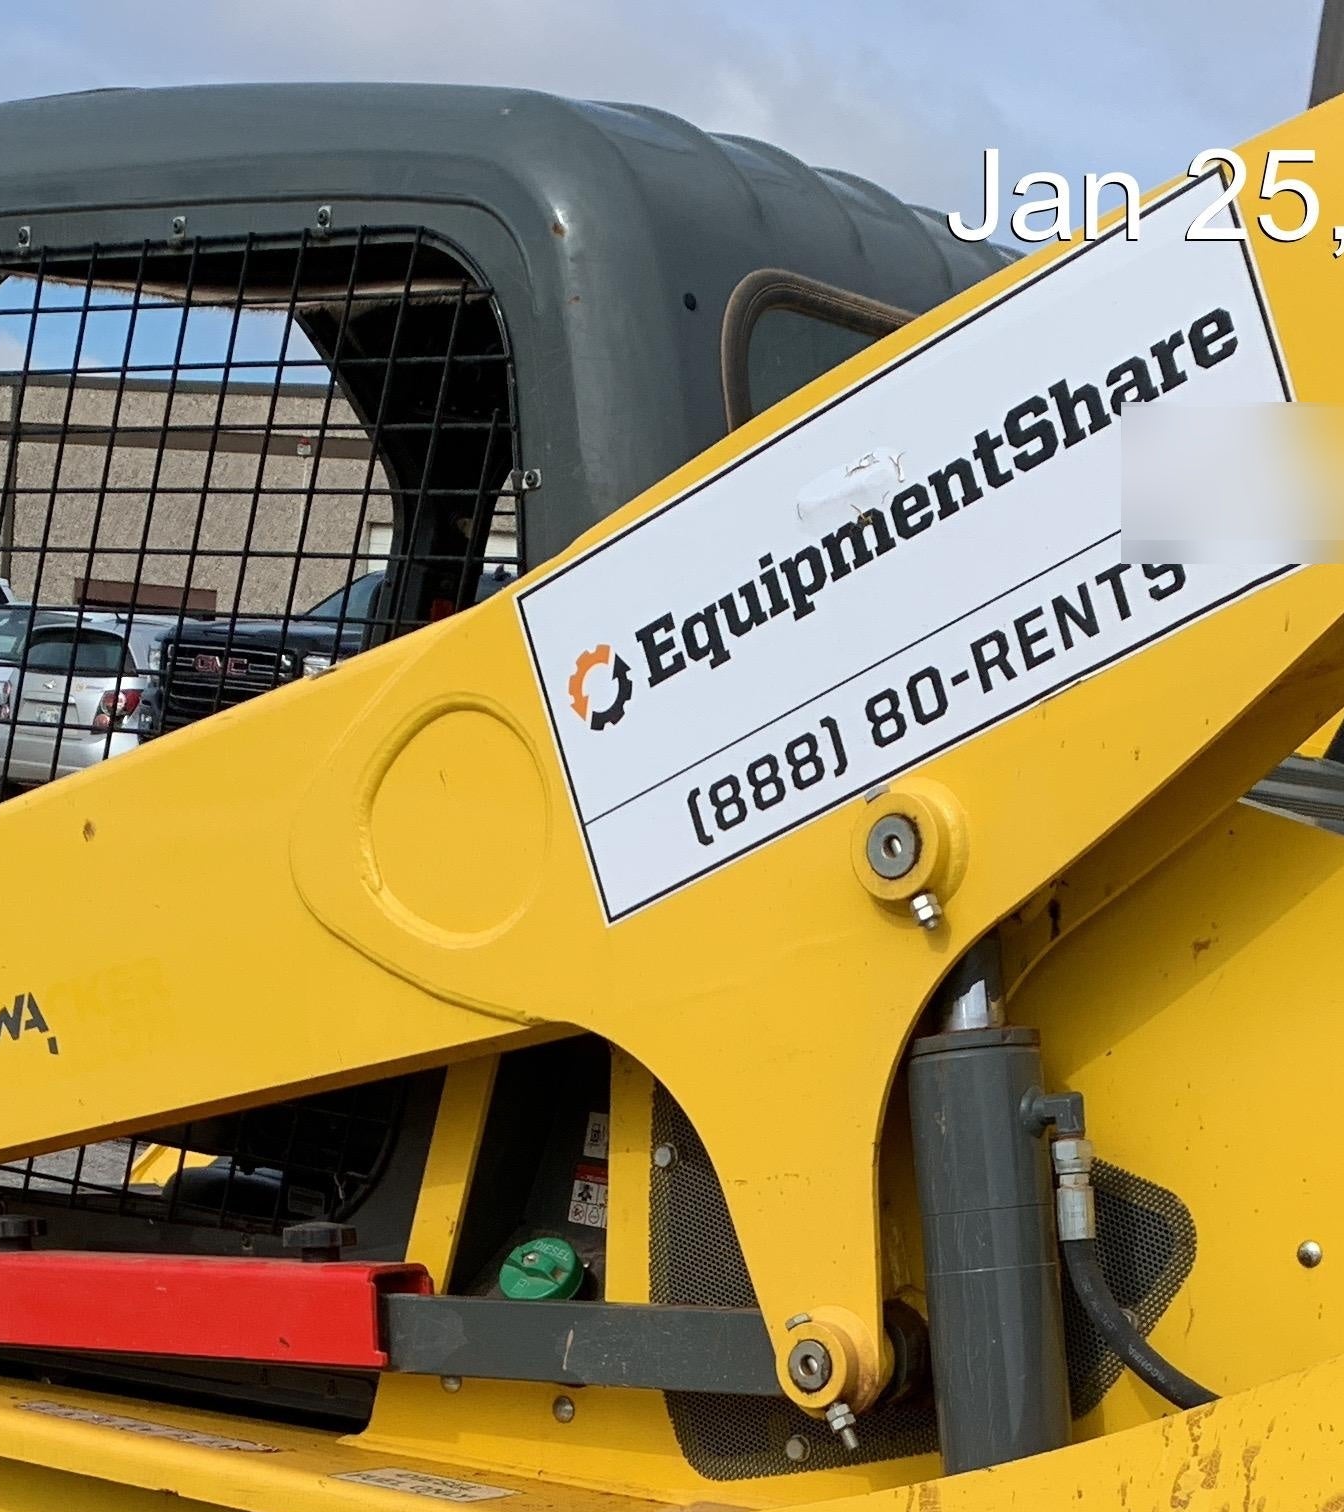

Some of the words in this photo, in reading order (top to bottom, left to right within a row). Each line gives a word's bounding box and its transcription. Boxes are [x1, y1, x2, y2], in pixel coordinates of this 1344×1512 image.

[635, 307, 1239, 688] EquipmentShare
[685, 716, 848, 846] (888)
[864, 562, 1188, 750] 80-RENTS
[534, 1240, 570, 1262] DIESEL
